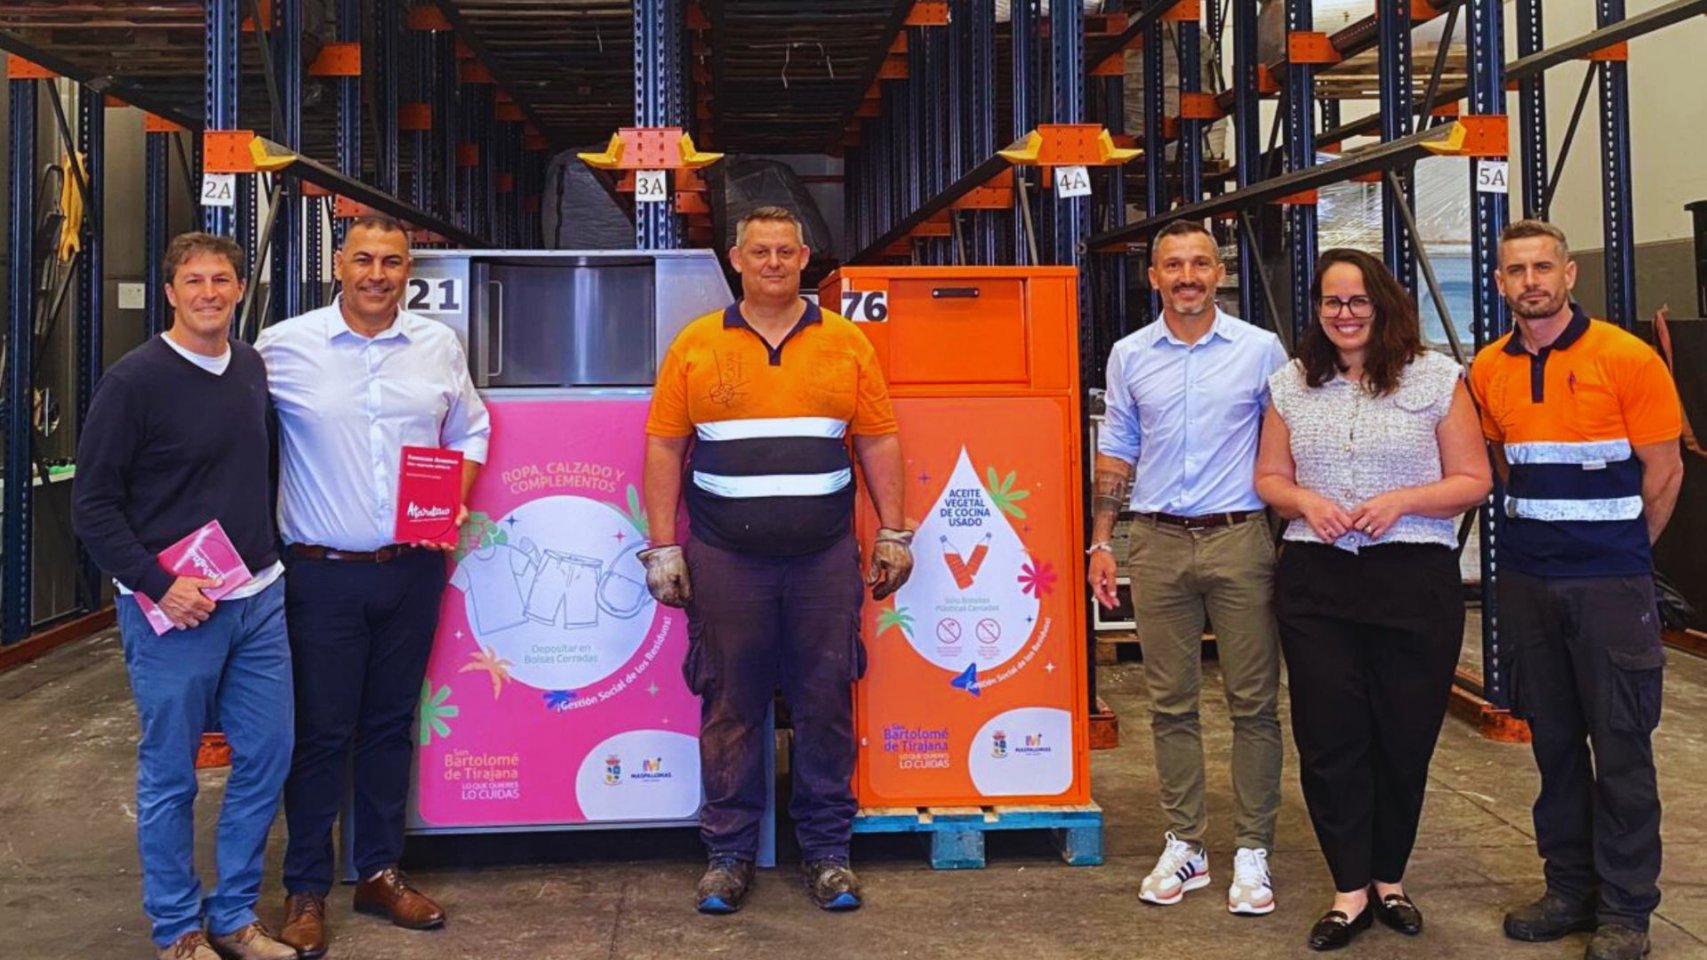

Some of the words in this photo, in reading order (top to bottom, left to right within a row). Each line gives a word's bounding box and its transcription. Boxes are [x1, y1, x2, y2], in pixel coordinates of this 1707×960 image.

[1060, 171, 1087, 190] 4A
[1479, 167, 1506, 186] 5A
[204, 180, 232, 199] 2A
[638, 177, 664, 195] 3A
[408, 278, 460, 310] 21
[842, 291, 888, 322] 76
[546, 462, 612, 478] CALZADO
[614, 470, 625, 482] Y
[510, 474, 616, 495] COMPLEMENTOS
[949, 489, 981, 498] ACEITE
[944, 499, 985, 508] VEGETAL
[940, 508, 953, 517] DE
[954, 508, 991, 517] COCINA
[949, 518, 982, 527] USADO
[531, 644, 577, 655] Depositar
[579, 645, 592, 653] en
[524, 655, 555, 664] Bolsas
[556, 654, 598, 664] Cerradas
[598, 680, 627, 701] Social
[625, 671, 638, 684] de
[634, 660, 649, 674] los
[884, 727, 949, 740] Bartolomé
[884, 740, 899, 752] de
[901, 740, 948, 753] Tirajana
[444, 752, 520, 767] Bartolomé
[899, 760, 913, 769] LO
[914, 759, 950, 769] CUIDAS
[443, 768, 462, 781] de
[464, 767, 518, 782] Tirajana
[462, 789, 477, 800] LO
[479, 788, 520, 800] CUIDAS
